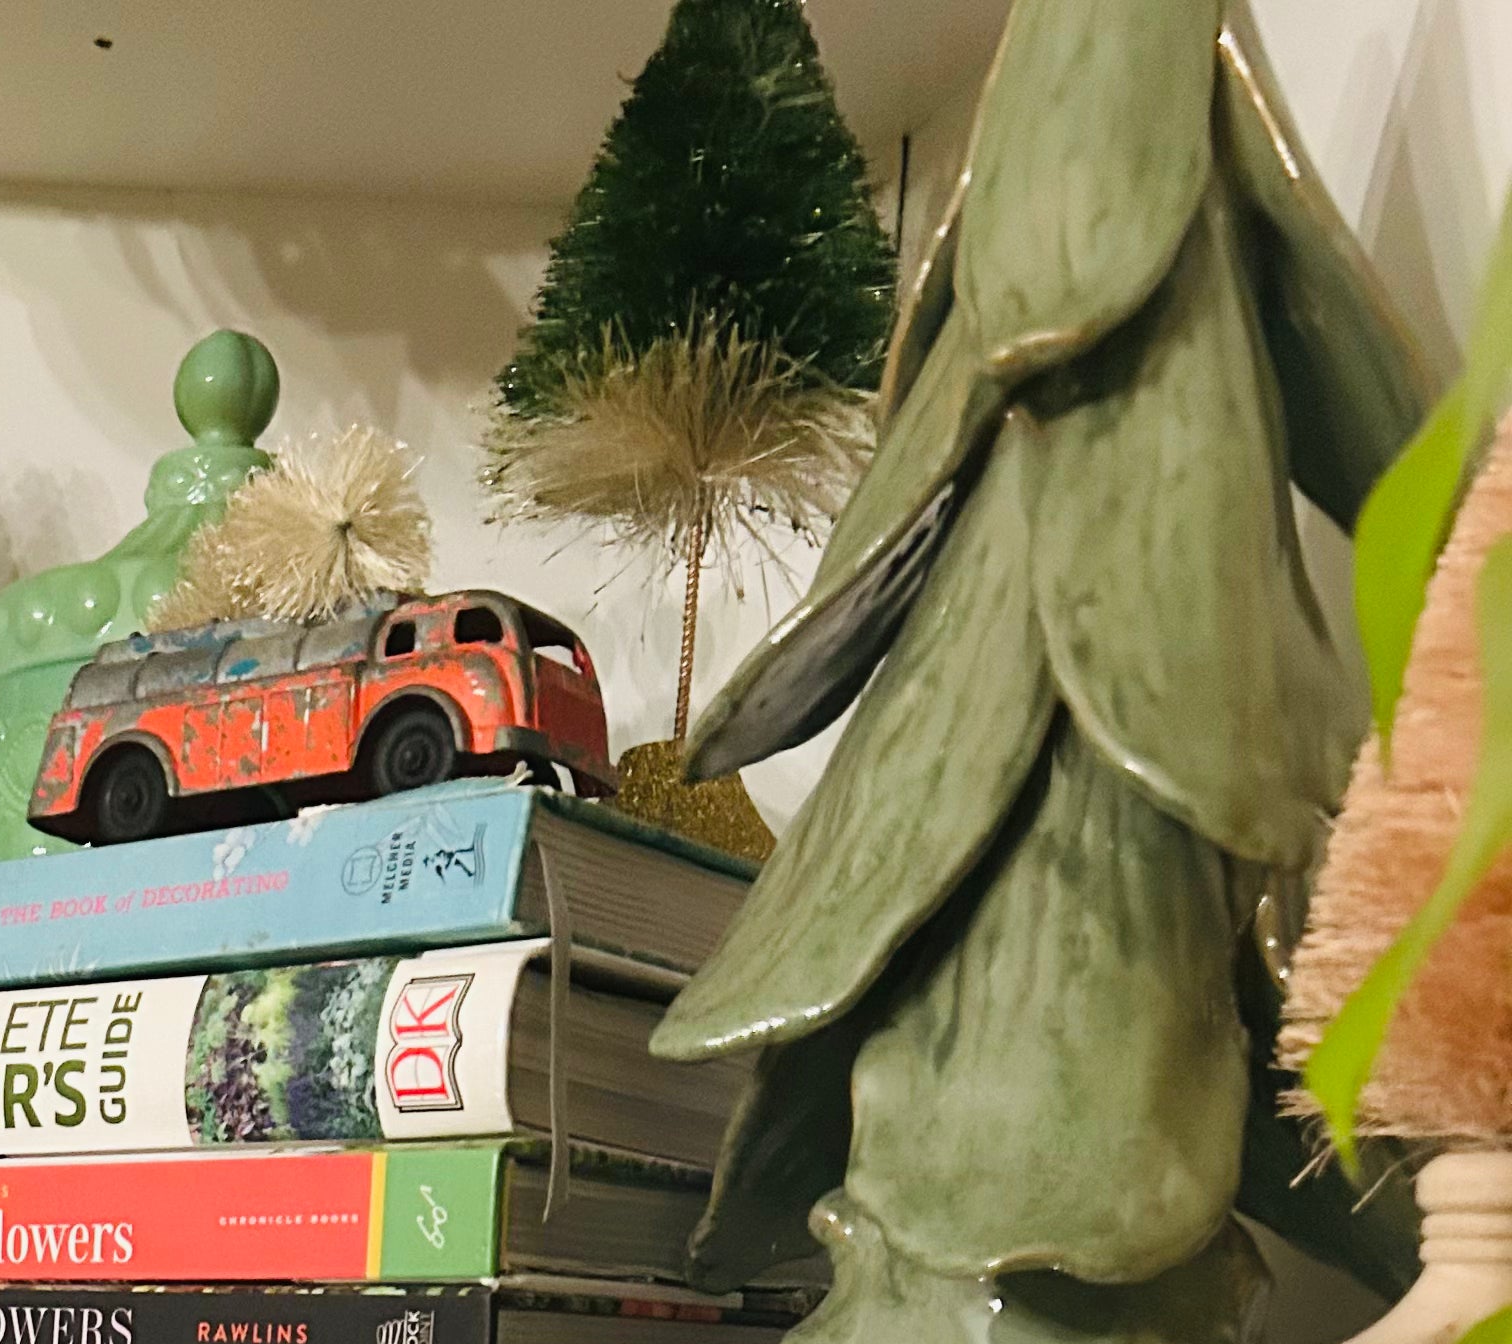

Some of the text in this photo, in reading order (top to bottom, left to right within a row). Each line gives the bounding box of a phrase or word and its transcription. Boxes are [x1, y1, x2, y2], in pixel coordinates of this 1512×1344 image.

[381, 832, 403, 904] MELCHER
[398, 840, 416, 891] MEDIA
[0, 869, 289, 926] THE BOOK of DECORATING
[99, 991, 143, 1124] GUIDE
[391, 984, 459, 1101] DK
[219, 1213, 359, 1226] CHRONICLE BOOKS
[197, 1321, 308, 1344] RAWLINS
